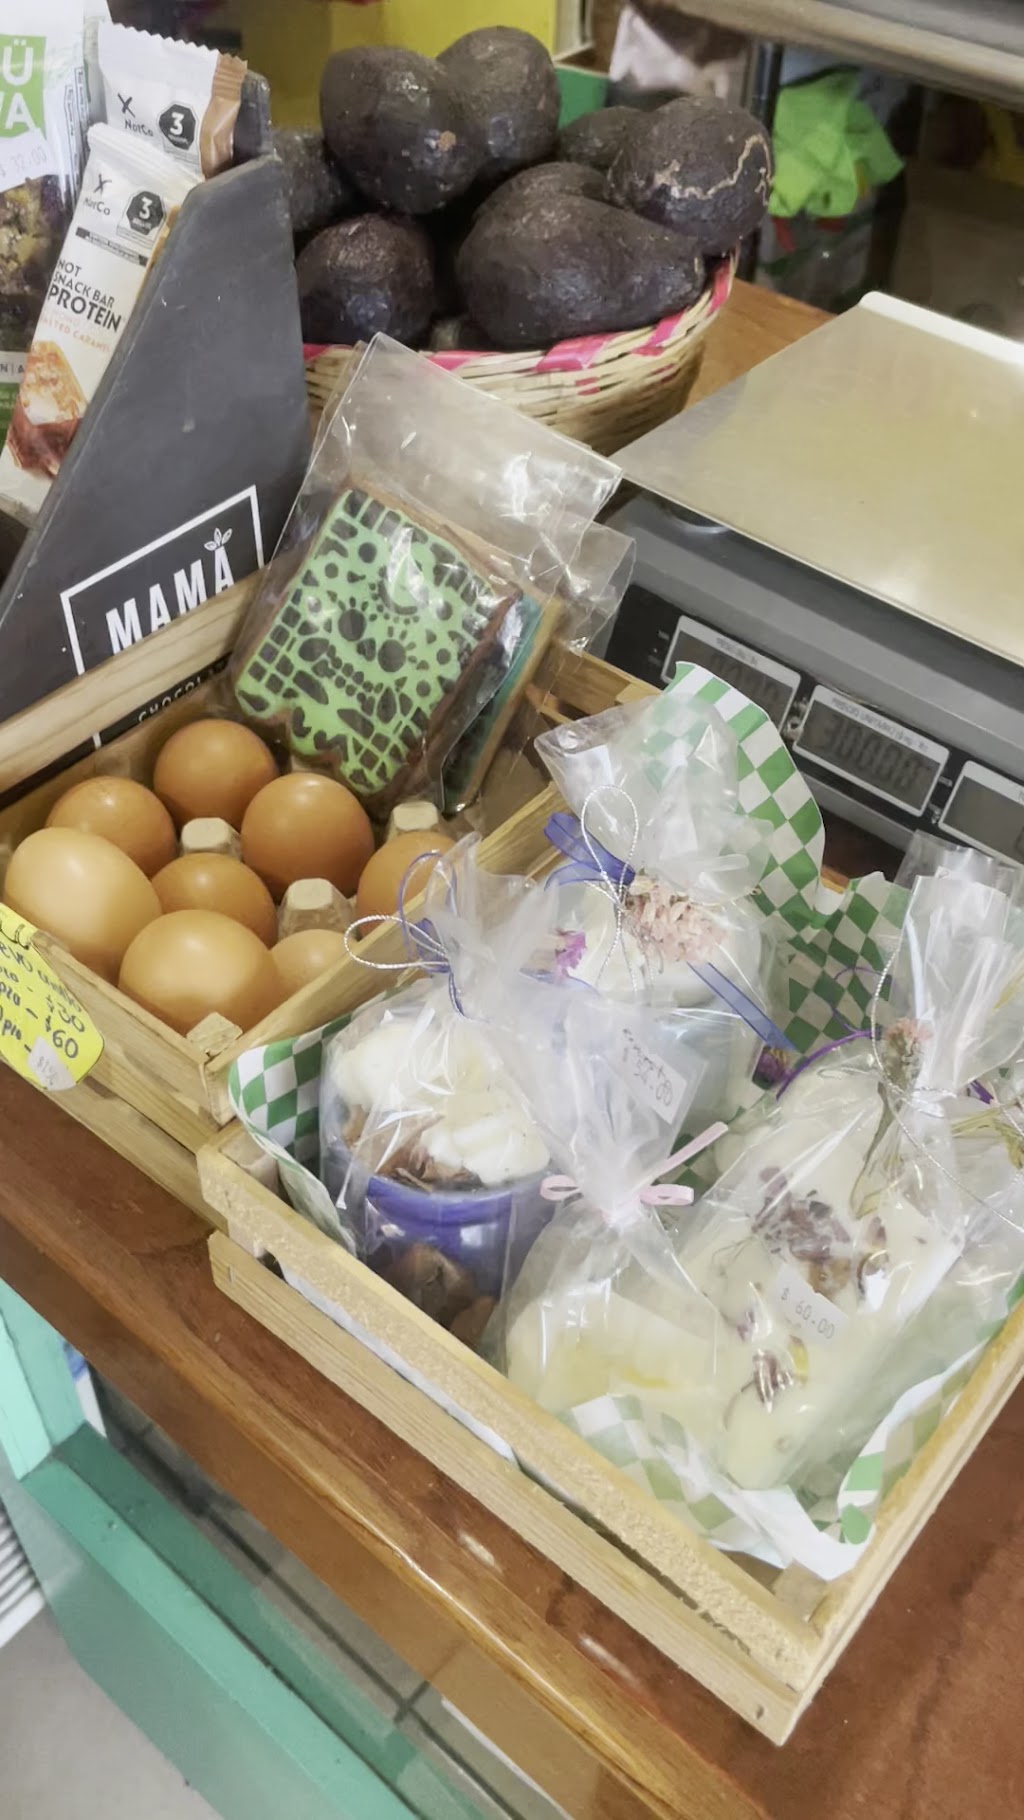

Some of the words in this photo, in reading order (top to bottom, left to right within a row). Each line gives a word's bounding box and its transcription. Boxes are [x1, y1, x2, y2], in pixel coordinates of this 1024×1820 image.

[0, 92, 36, 129] A
[169, 112, 184, 136] 3
[125, 119, 154, 138] NotCo
[139, 197, 153, 219] 3
[58, 258, 82, 277] NOT
[53, 271, 91, 298] SNACK
[93, 289, 116, 309] BAR
[48, 284, 122, 333] PROTEIN
[45, 1015, 79, 1059] $60
